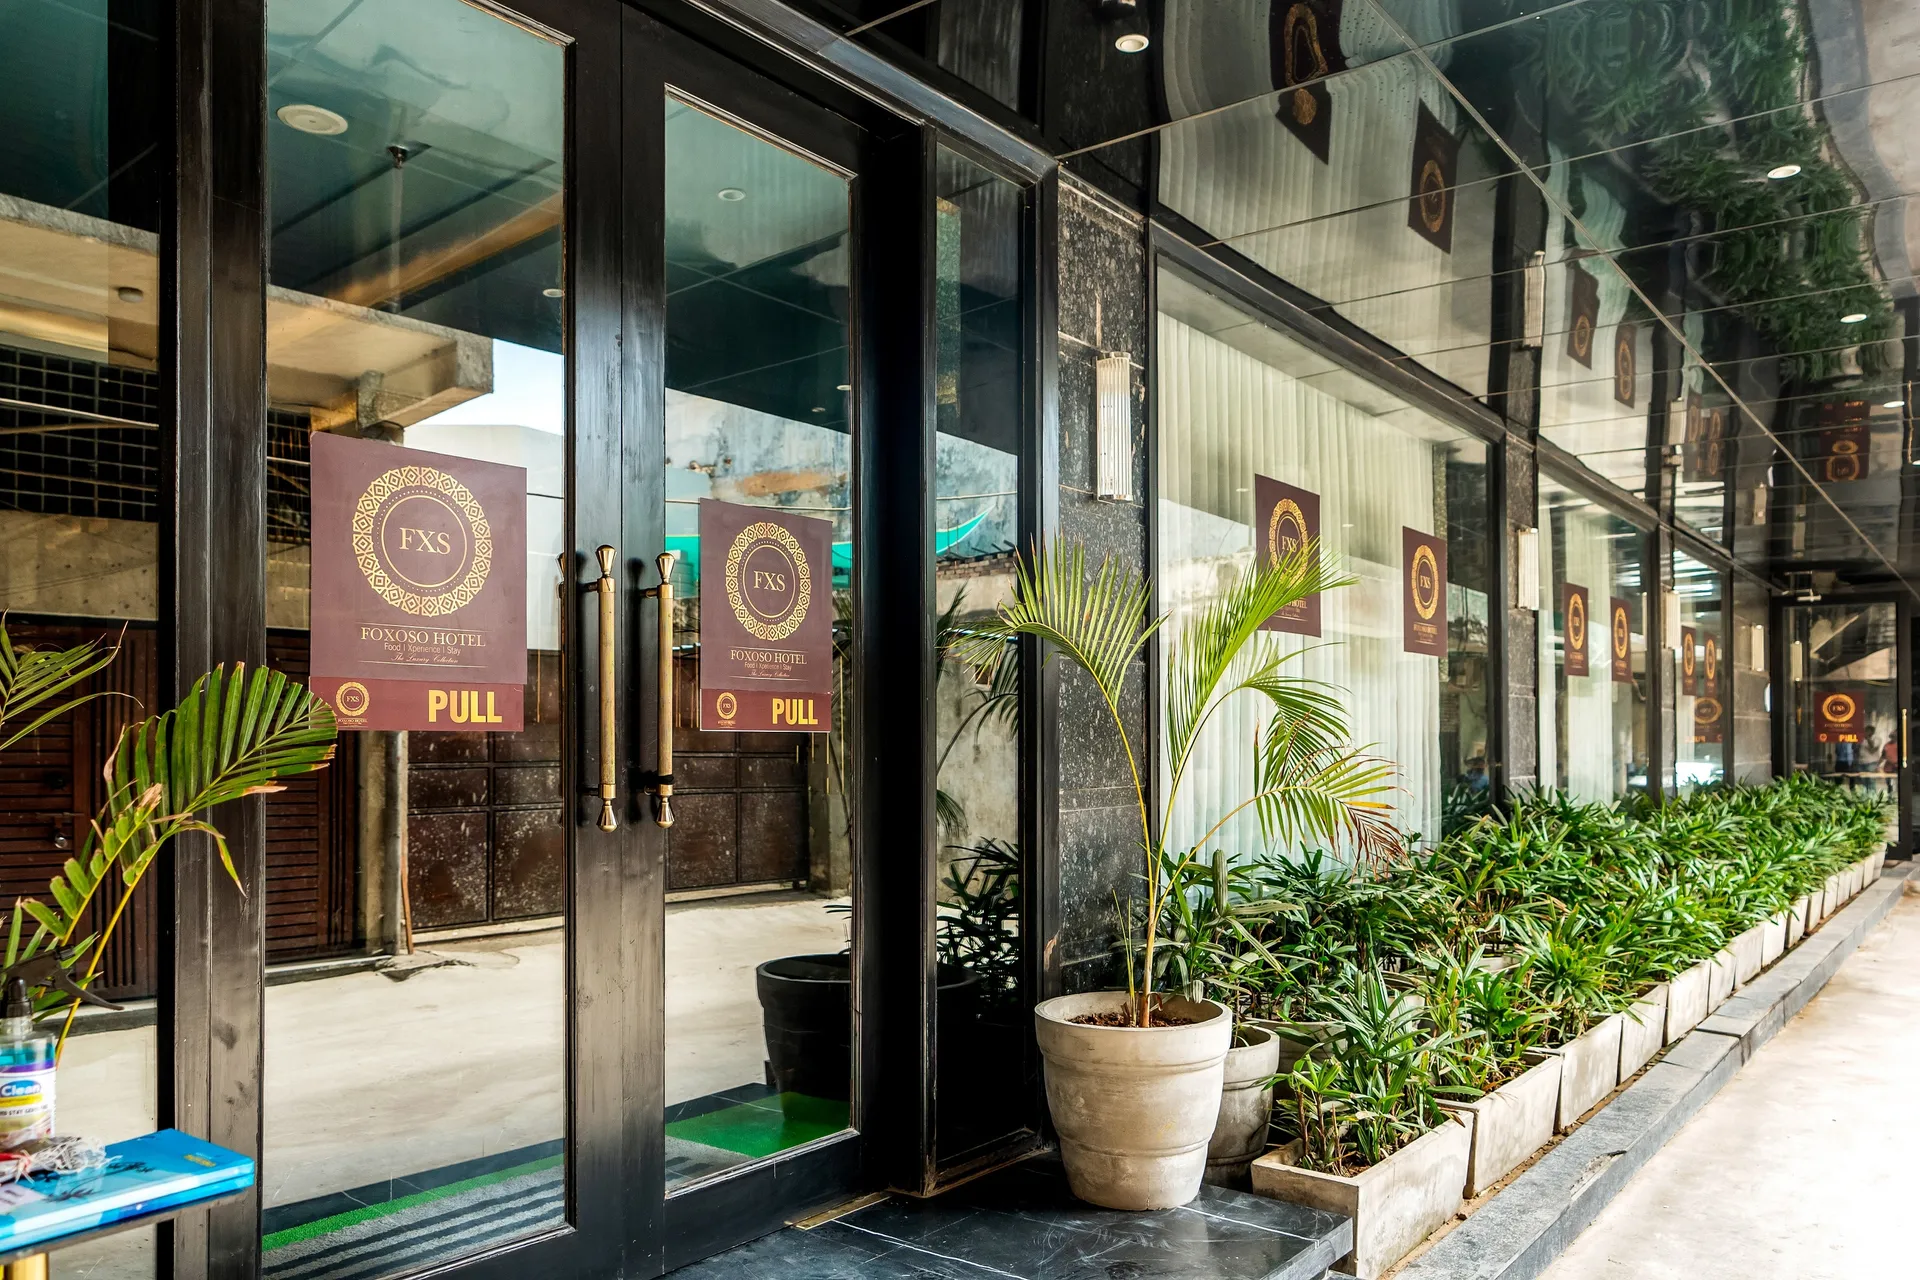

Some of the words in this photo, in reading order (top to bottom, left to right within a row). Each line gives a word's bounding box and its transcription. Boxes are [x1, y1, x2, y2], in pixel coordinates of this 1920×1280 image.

[399, 527, 451, 555] FXS
[1282, 535, 1297, 553] FXS
[753, 570, 786, 592] FXS
[360, 627, 429, 644] FOXOSO
[433, 631, 486, 647] HOTEL
[384, 642, 401, 652] Food
[407, 643, 441, 654] Xperience
[446, 645, 462, 656] Stay
[730, 649, 772, 662] FOXOSO
[774, 652, 808, 665] HOTEL
[428, 689, 503, 724] PULL
[772, 698, 818, 725] PULL
[1839, 733, 1859, 743] PULL
